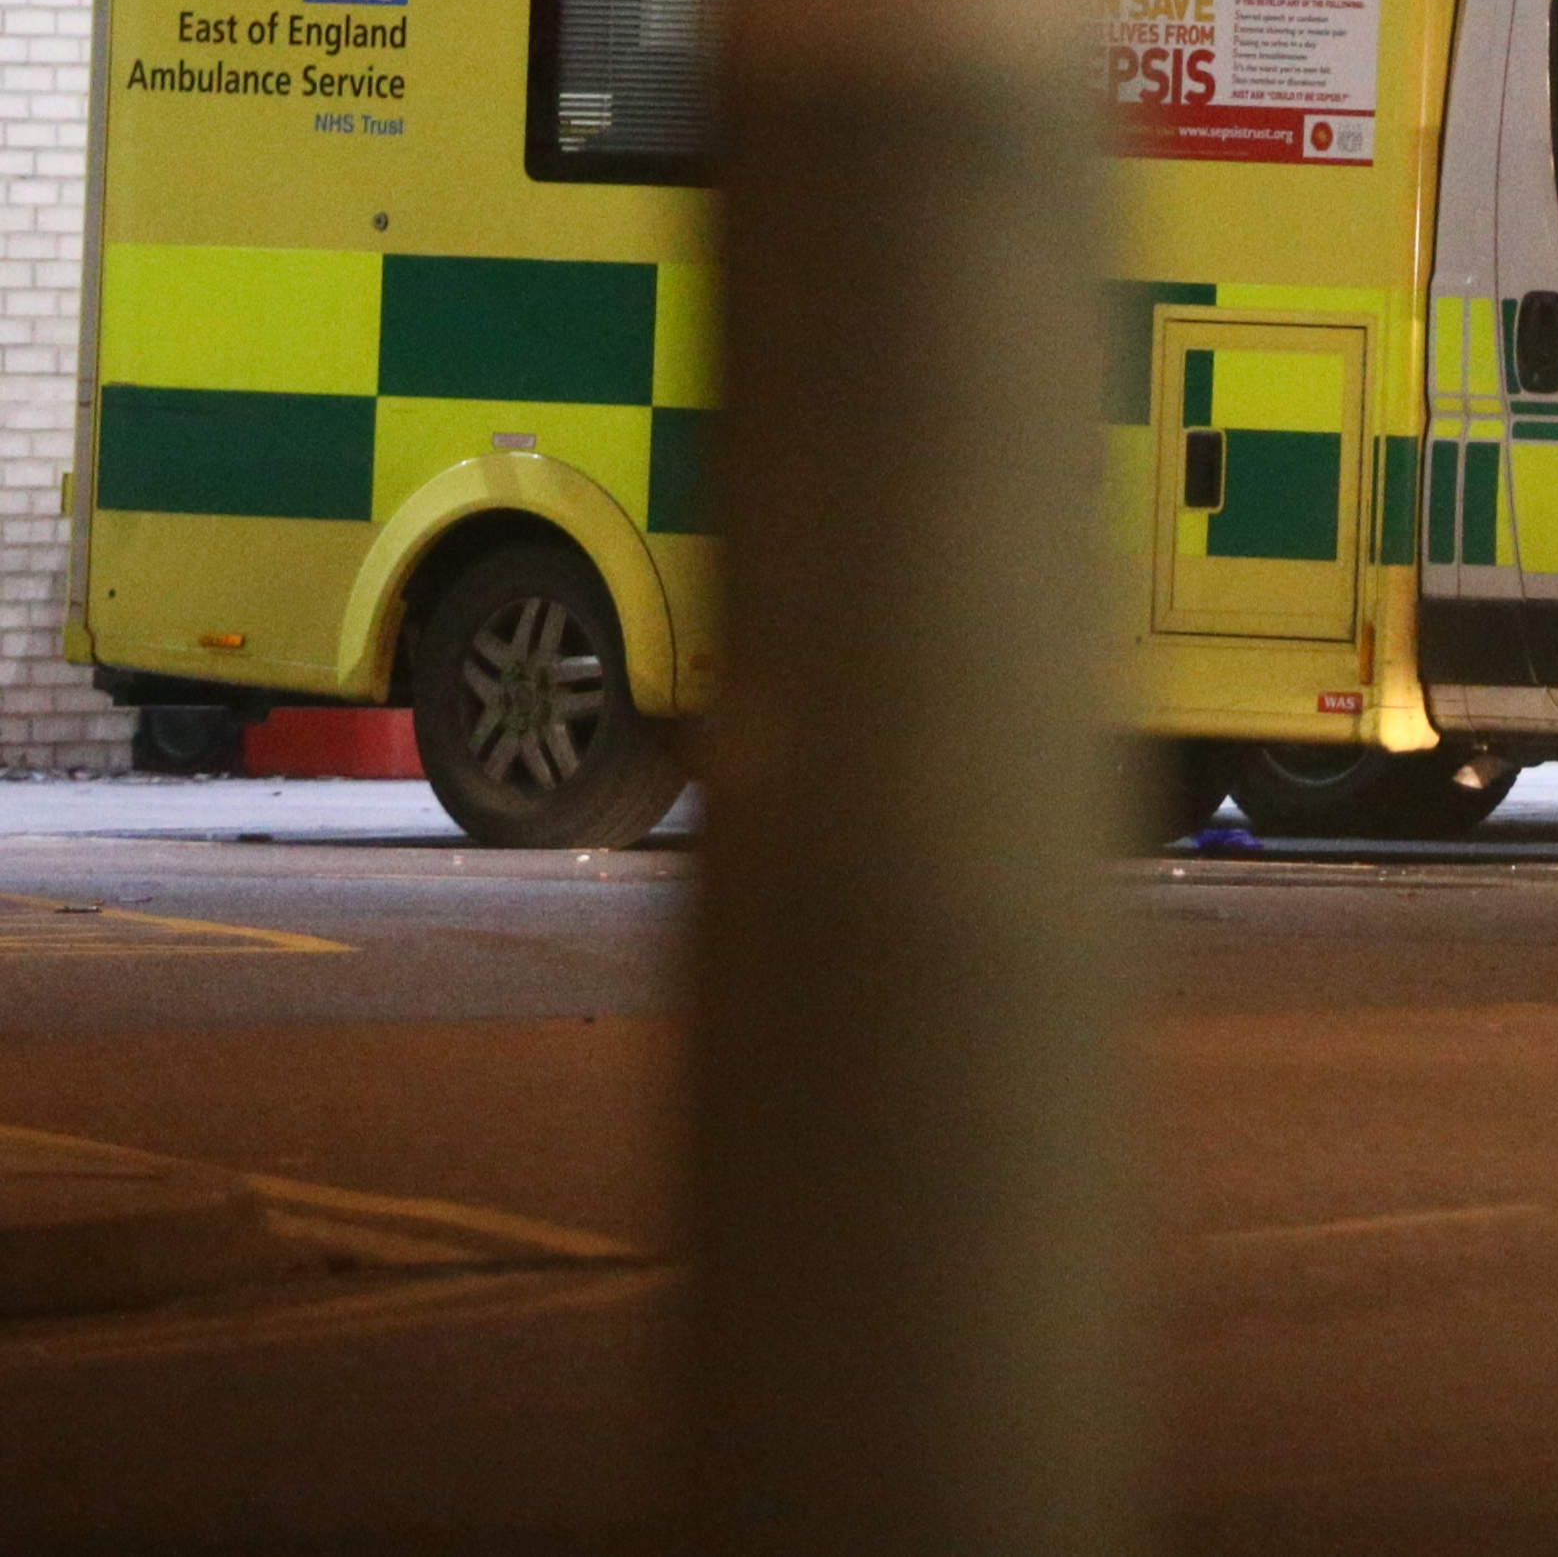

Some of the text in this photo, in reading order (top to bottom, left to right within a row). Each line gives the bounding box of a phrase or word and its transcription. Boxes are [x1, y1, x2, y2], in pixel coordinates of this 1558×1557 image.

[178, 11, 407, 55] East of England
[1164, 24, 1215, 47] FROM
[127, 58, 406, 99] Ambulance Service
[314, 113, 405, 136] NHS Trust
[1179, 125, 1294, 145] www.sepsistrust.org
[1323, 696, 1355, 710] WAS
